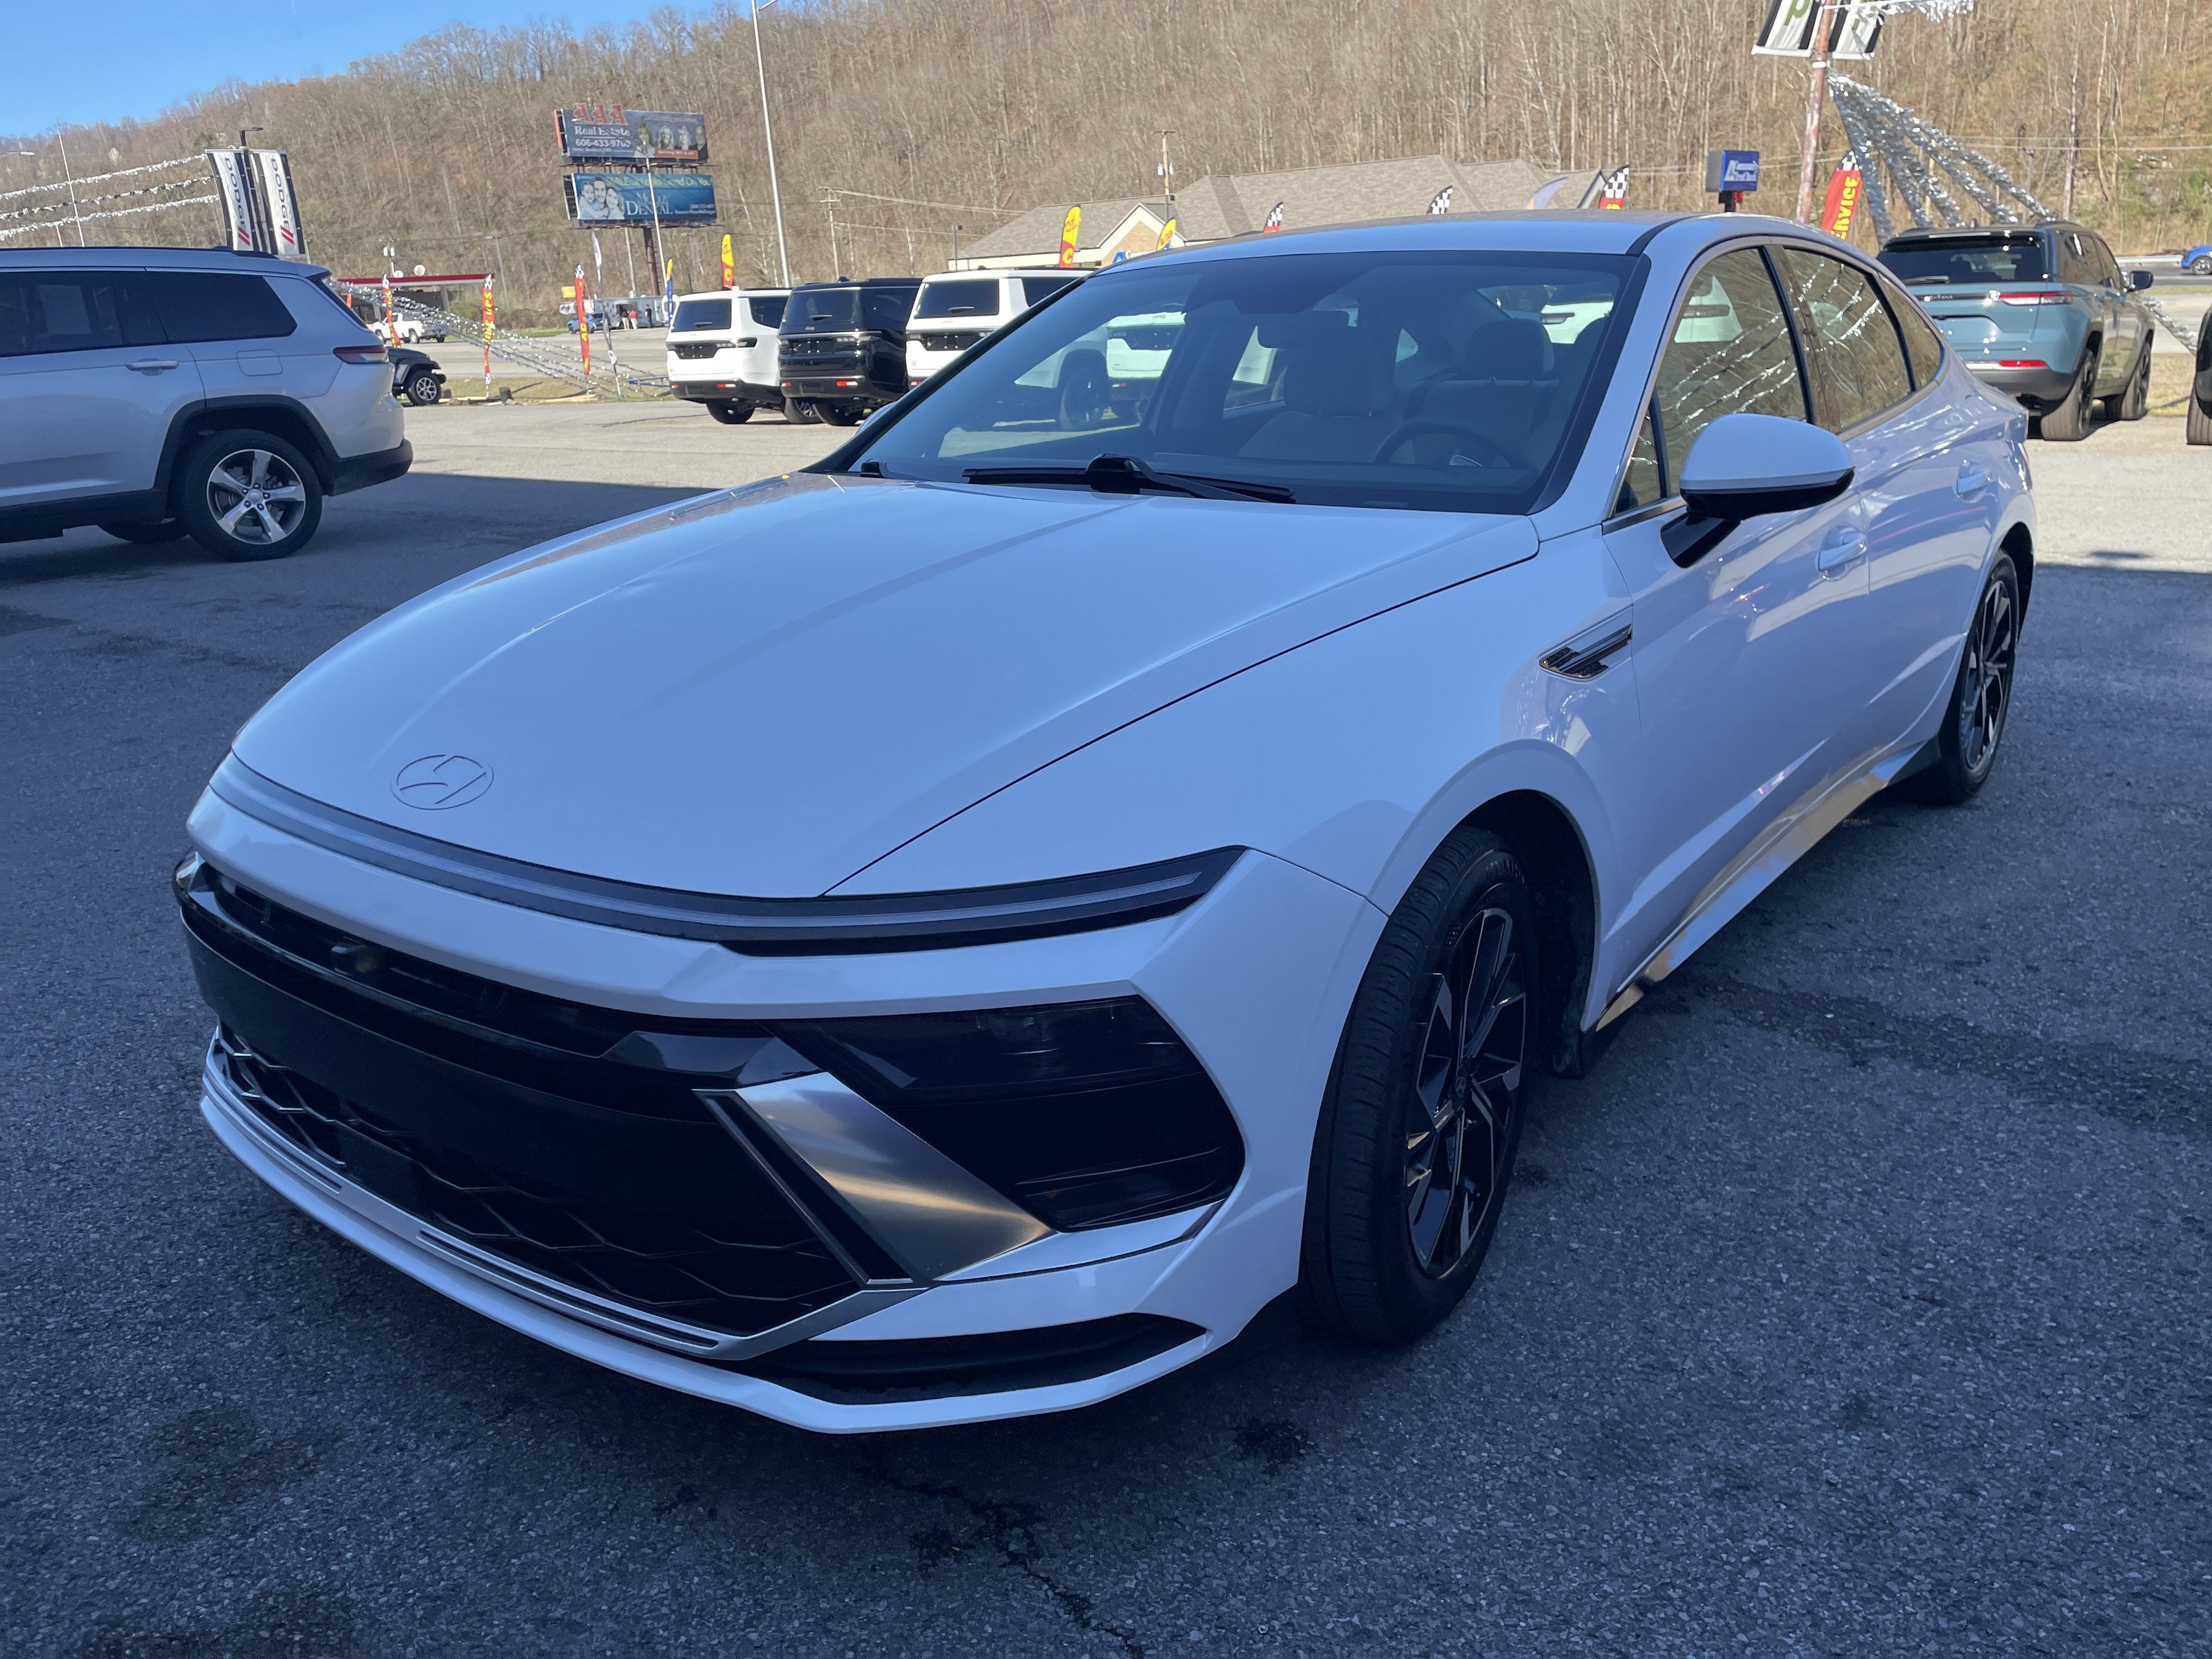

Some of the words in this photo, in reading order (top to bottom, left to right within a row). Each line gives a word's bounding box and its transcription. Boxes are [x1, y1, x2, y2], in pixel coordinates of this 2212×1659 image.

[573, 103, 628, 126] AAA
[574, 126, 597, 136] Real
[598, 127, 631, 137] Etate
[225, 157, 246, 232] DODGE
[271, 159, 290, 232] DODGE
[625, 200, 673, 216] DENAL
